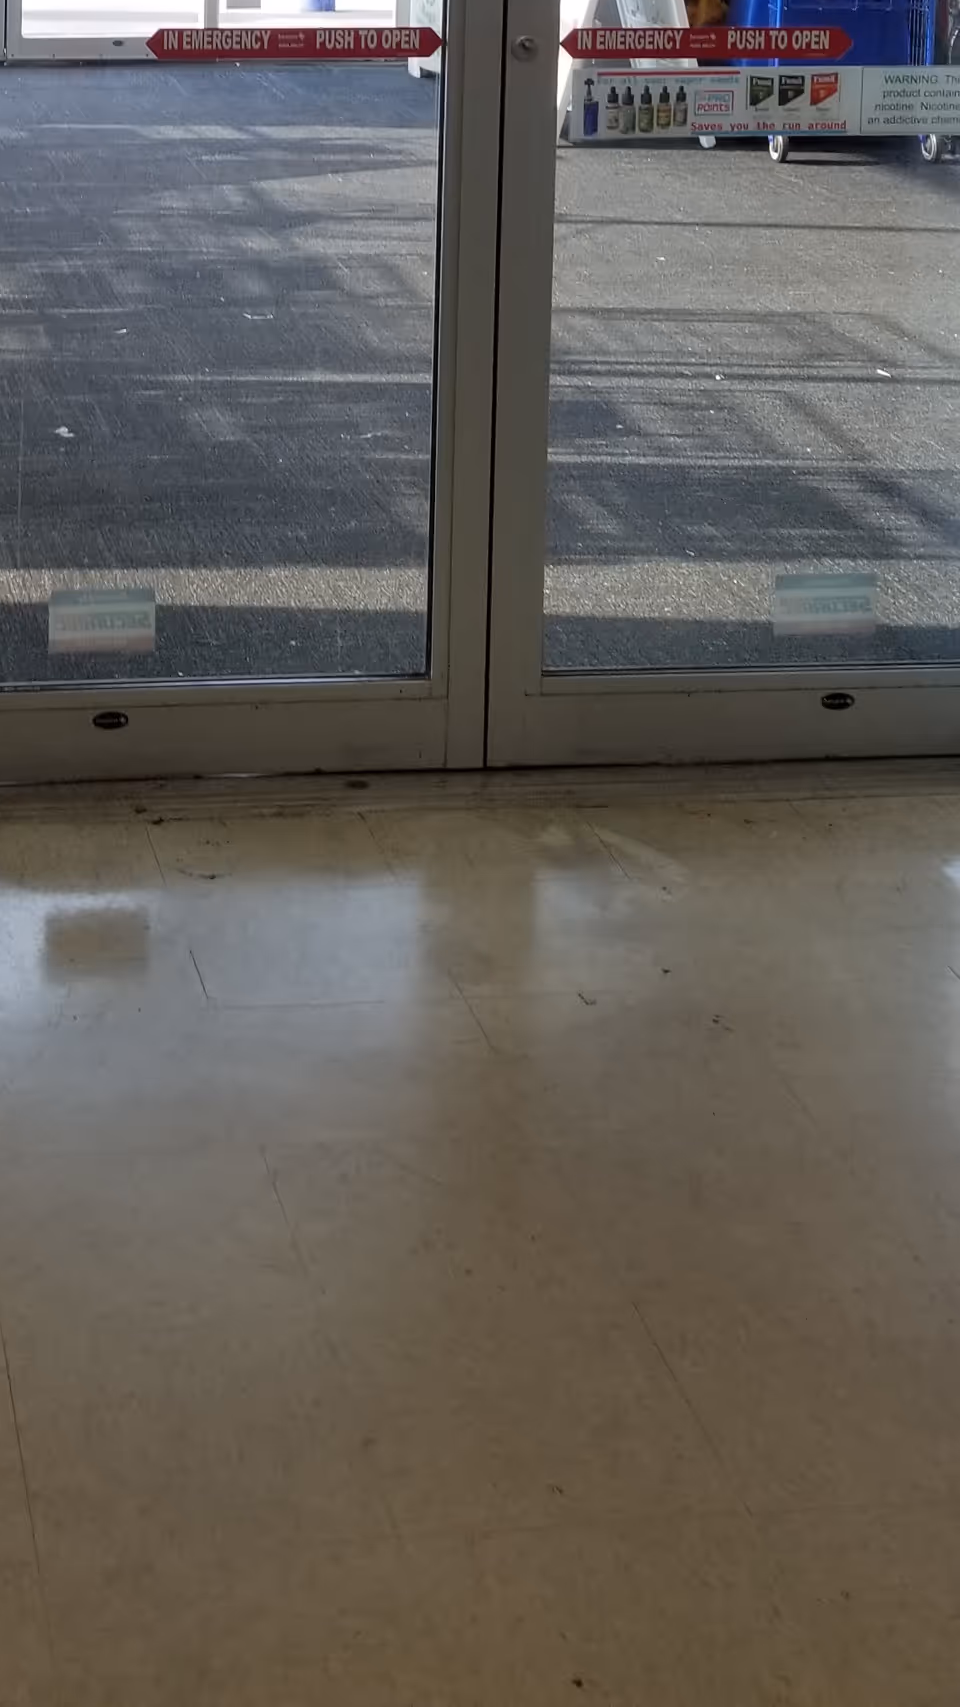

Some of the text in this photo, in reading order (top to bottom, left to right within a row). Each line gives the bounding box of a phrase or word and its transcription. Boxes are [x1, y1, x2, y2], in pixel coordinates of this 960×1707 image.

[163, 29, 179, 50] IN
[182, 29, 271, 50] EMERGENCY
[315, 29, 355, 49] PUSH
[358, 29, 378, 50] TO
[381, 29, 420, 49] OPEN
[577, 30, 830, 50] IN EMERGENCY PUSH TO OPEN
[882, 88, 921, 99] product
[691, 120, 847, 132] Saves you the run around
[867, 115, 928, 125] an addictive
